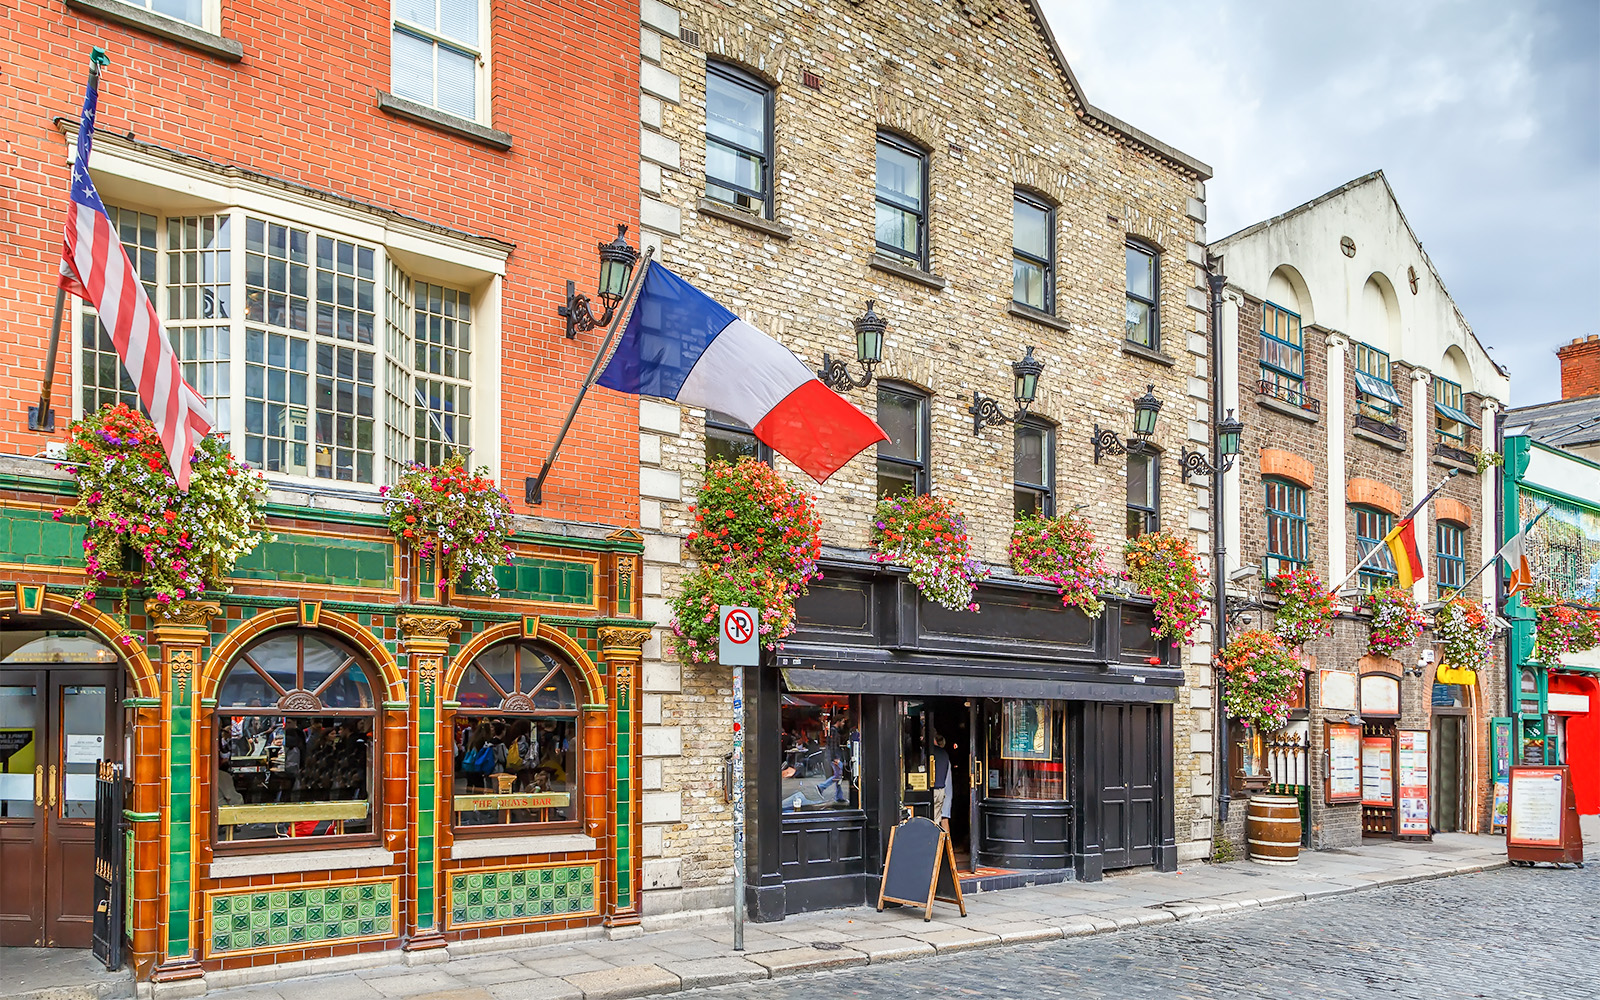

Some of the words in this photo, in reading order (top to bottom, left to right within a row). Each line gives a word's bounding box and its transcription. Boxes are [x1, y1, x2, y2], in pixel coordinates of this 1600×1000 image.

[735, 616, 747, 637] P
[472, 799, 493, 808] THE
[497, 798, 529, 807] QUAYS
[532, 798, 551, 806] BAR
